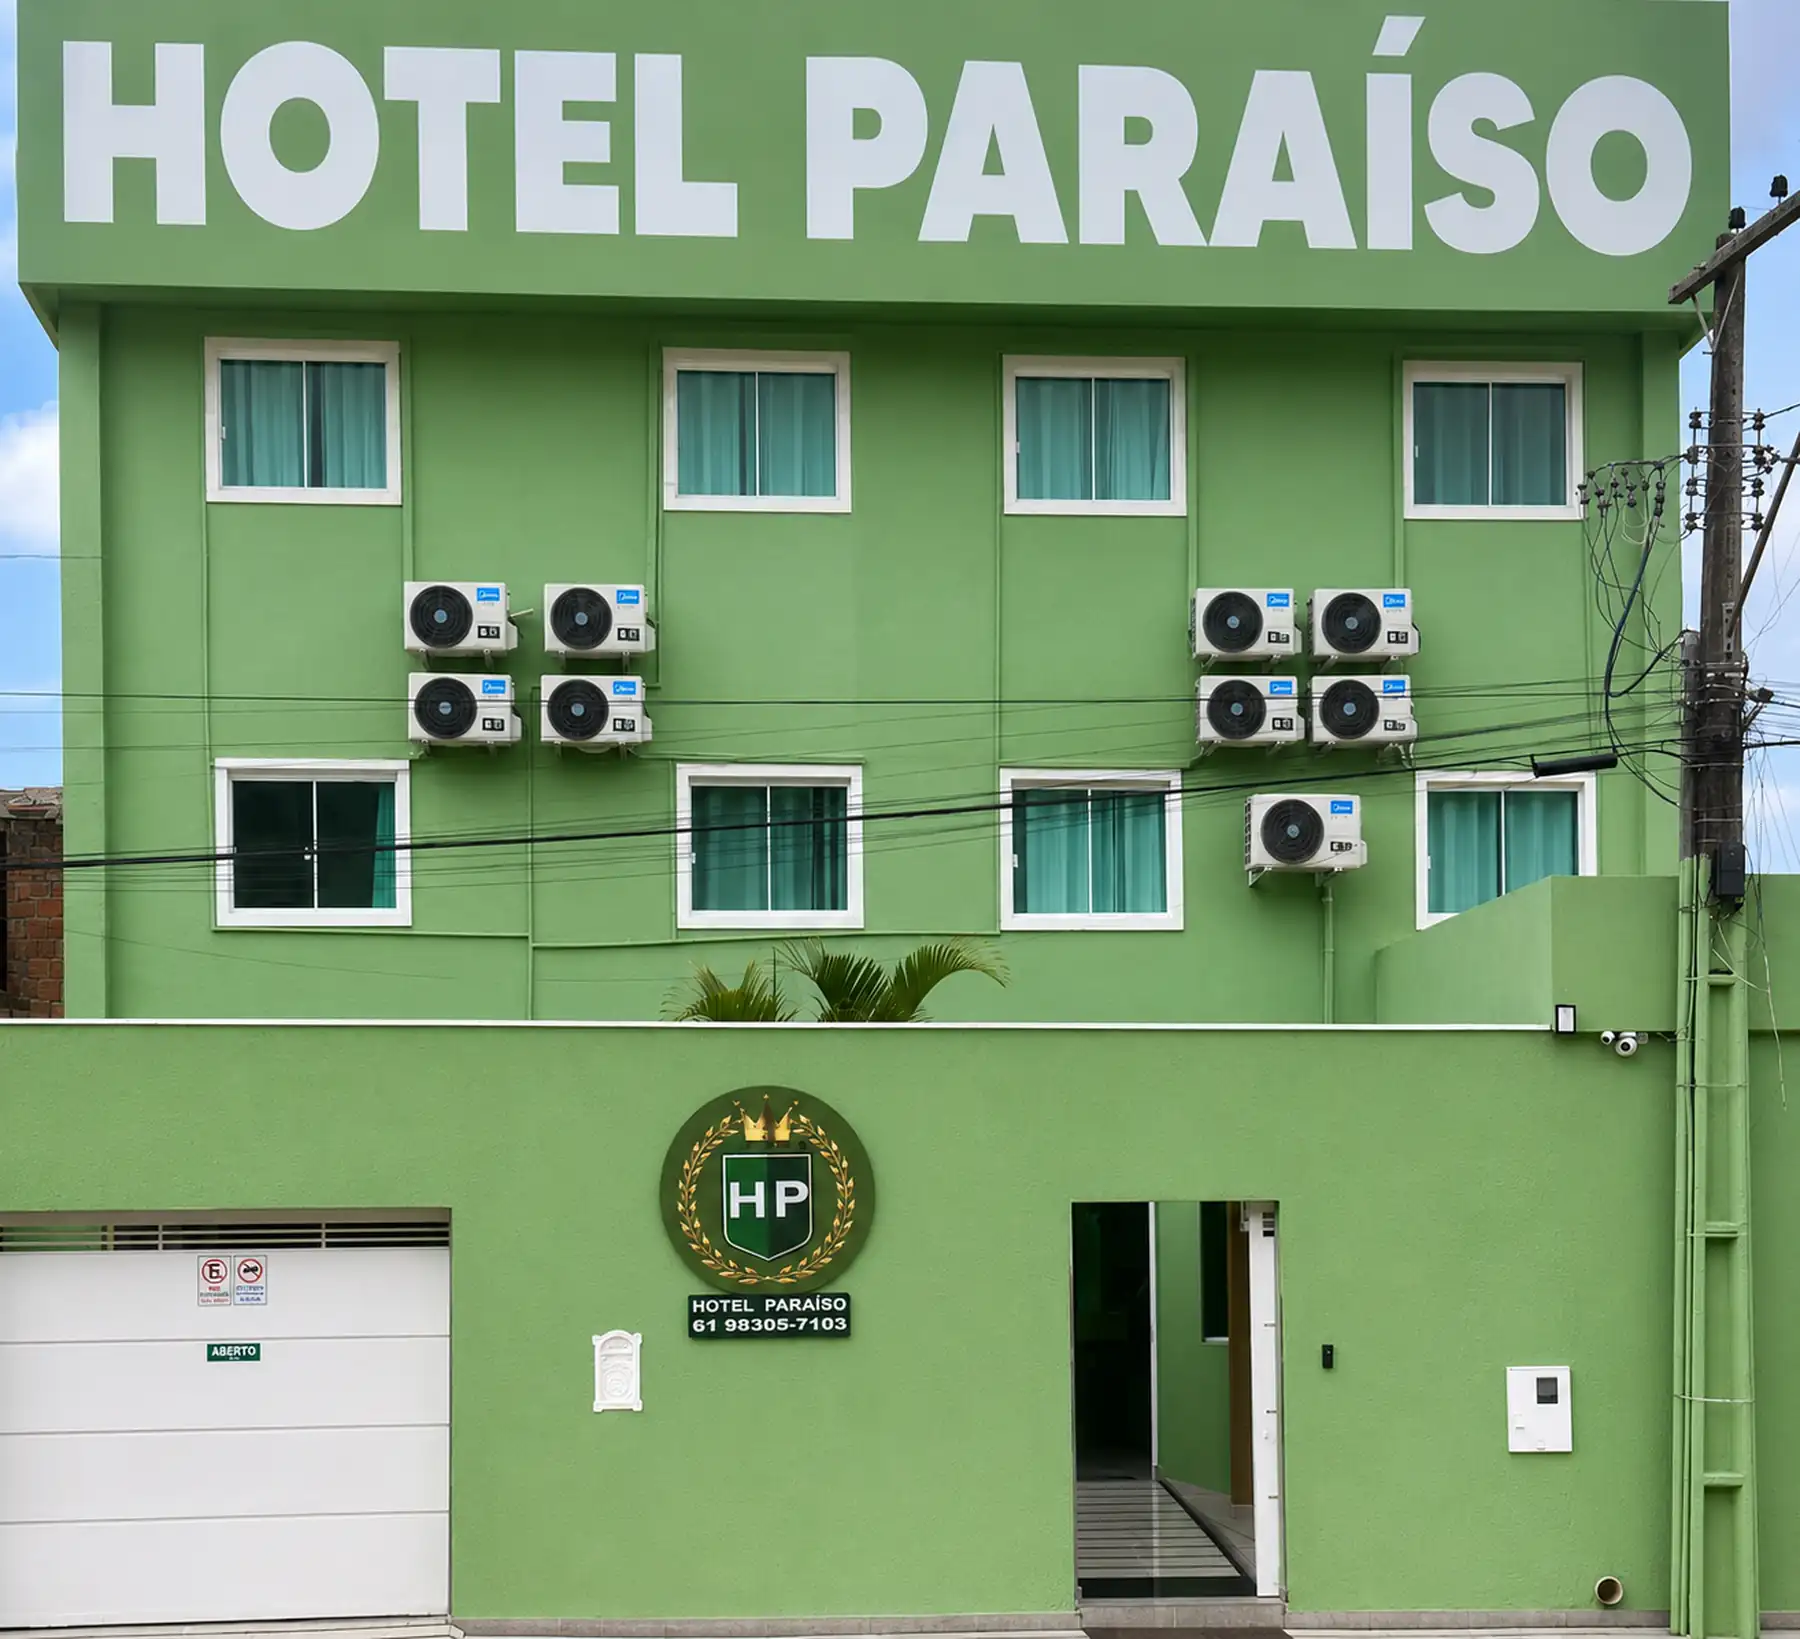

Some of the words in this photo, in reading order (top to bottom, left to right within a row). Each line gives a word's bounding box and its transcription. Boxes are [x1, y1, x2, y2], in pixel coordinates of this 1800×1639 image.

[63, 40, 738, 237] HOTEL
[806, 15, 1692, 256] PARAÍSO
[730, 1180, 808, 1218] HP
[692, 1299, 754, 1313] HOTEL
[765, 1295, 847, 1312] PARAÍSO
[692, 1319, 716, 1332] 61
[725, 1318, 848, 1331] 98305-7103
[211, 1346, 256, 1356] ABERTO
